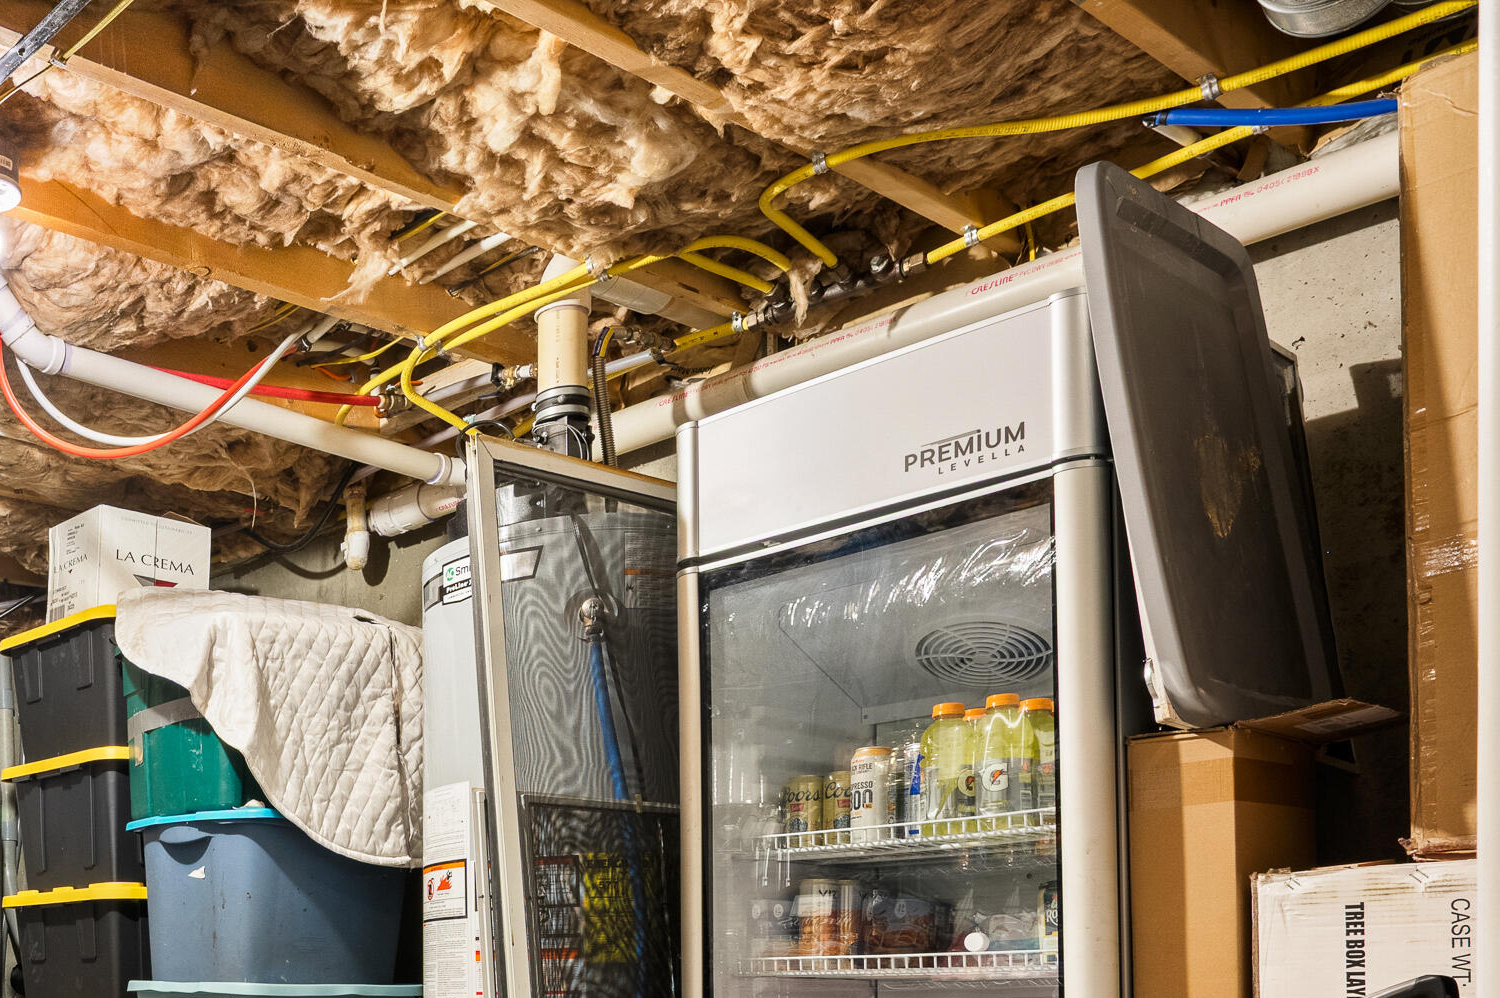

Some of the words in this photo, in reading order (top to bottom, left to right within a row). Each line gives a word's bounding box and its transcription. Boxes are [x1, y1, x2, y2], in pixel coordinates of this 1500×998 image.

[904, 421, 1025, 473] PREMIUM
[938, 444, 1025, 475] LEVELLA
[63, 553, 88, 570] CREMA
[116, 548, 136, 564] LA
[141, 554, 195, 576] CREMA
[1344, 901, 1366, 937] TREE
[1450, 897, 1472, 949] CASE
[1345, 939, 1366, 969] BOX
